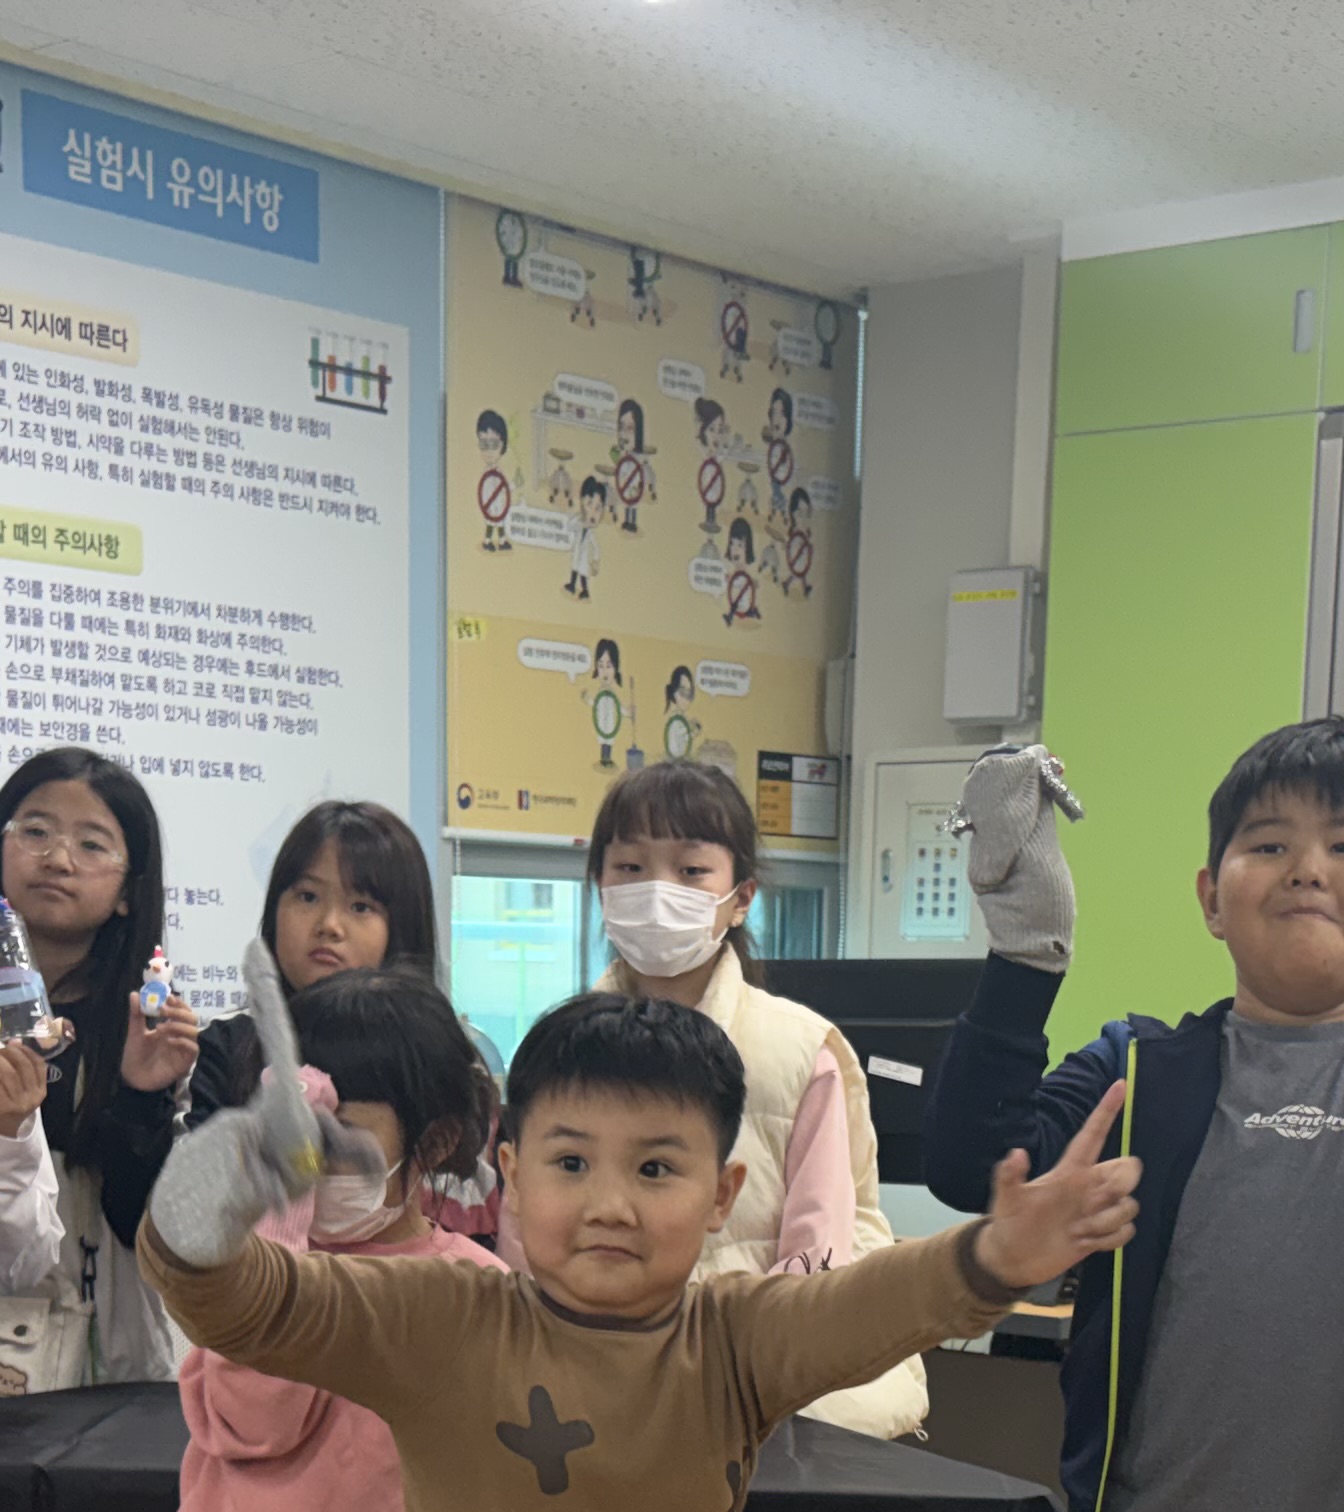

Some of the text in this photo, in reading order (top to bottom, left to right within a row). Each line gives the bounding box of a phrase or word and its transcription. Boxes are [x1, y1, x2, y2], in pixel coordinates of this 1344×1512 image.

[62, 128, 283, 232] 실험시 유의사항
[20, 309, 73, 342] 지시에
[78, 321, 129, 353] 따른다
[11, 361, 40, 386] 있는
[12, 522, 47, 550] 때의
[53, 527, 121, 560] 주의사항
[2, 576, 44, 600] 주의를
[49, 582, 102, 608] 집중하여
[106, 590, 145, 613] 조용한
[4, 605, 45, 629] 물질을
[49, 611, 76, 632] 다룰
[80, 615, 120, 637] 때에는
[123, 618, 150, 640] 특히
[5, 634, 46, 656] 기체가
[49, 638, 91, 661] 발생할
[94, 643, 133, 664] 것으로
[137, 647, 188, 671] 예상되는
[4, 660, 46, 682] 손으로
[50, 666, 116, 690] 부채질하여
[162, 677, 188, 696] 하고
[5, 688, 47, 712] 물질이
[108, 699, 159, 721] 가능성이
[163, 704, 201, 725] 있거나
[38, 720, 91, 747] 보안경을
[95, 725, 126, 745] 쓴다.
